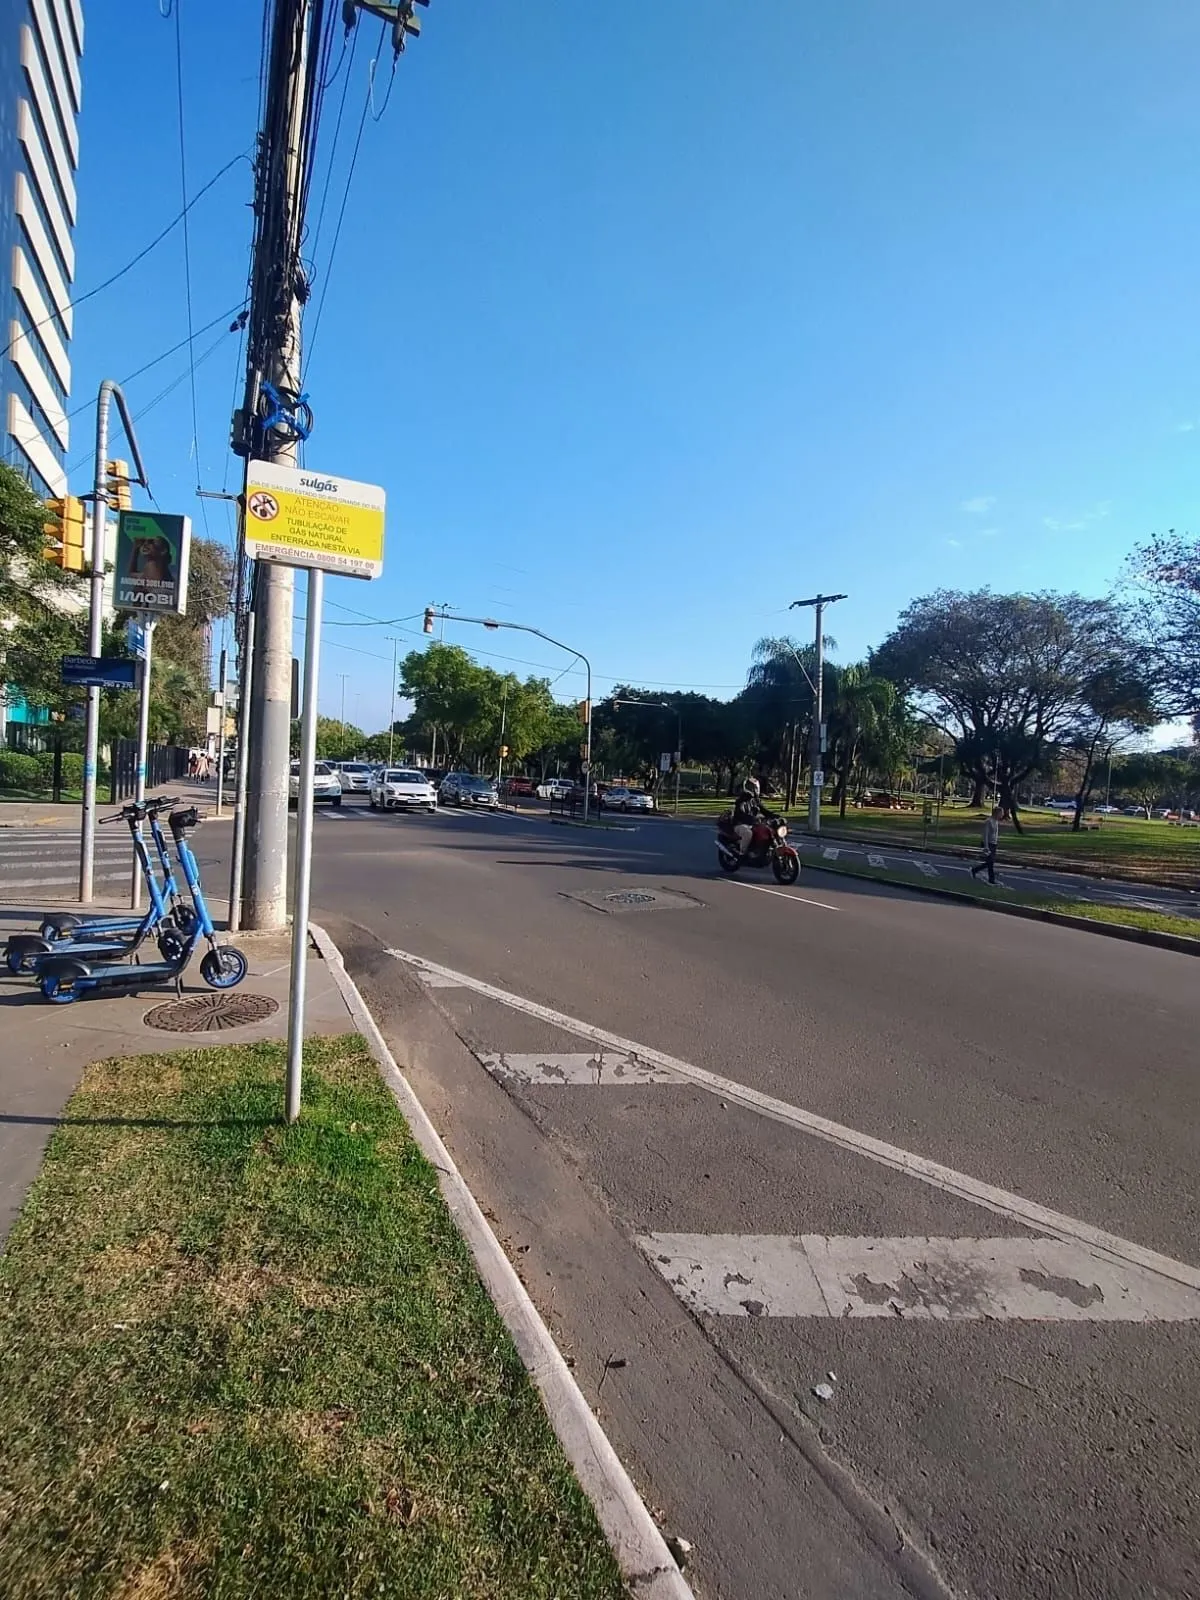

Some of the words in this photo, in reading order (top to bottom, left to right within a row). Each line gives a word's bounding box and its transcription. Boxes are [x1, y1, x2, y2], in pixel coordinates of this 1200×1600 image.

[299, 477, 339, 493] sulgás
[295, 496, 340, 513] ATENÇÃO
[284, 505, 306, 517] NÃO
[308, 511, 350, 524] ESCAVAR
[286, 517, 335, 534] TUBULAÇÃO
[336, 527, 348, 535] DE
[271, 533, 322, 548] ENTERRADA
[322, 540, 347, 554] NESTA
[347, 546, 361, 556] VIA
[308, 530, 344, 544] NATURAL
[316, 554, 336, 564] 0800
[338, 557, 348, 565] 54
[349, 559, 363, 568] 197
[364, 561, 375, 570] 00
[119, 590, 174, 606] IMOBI
